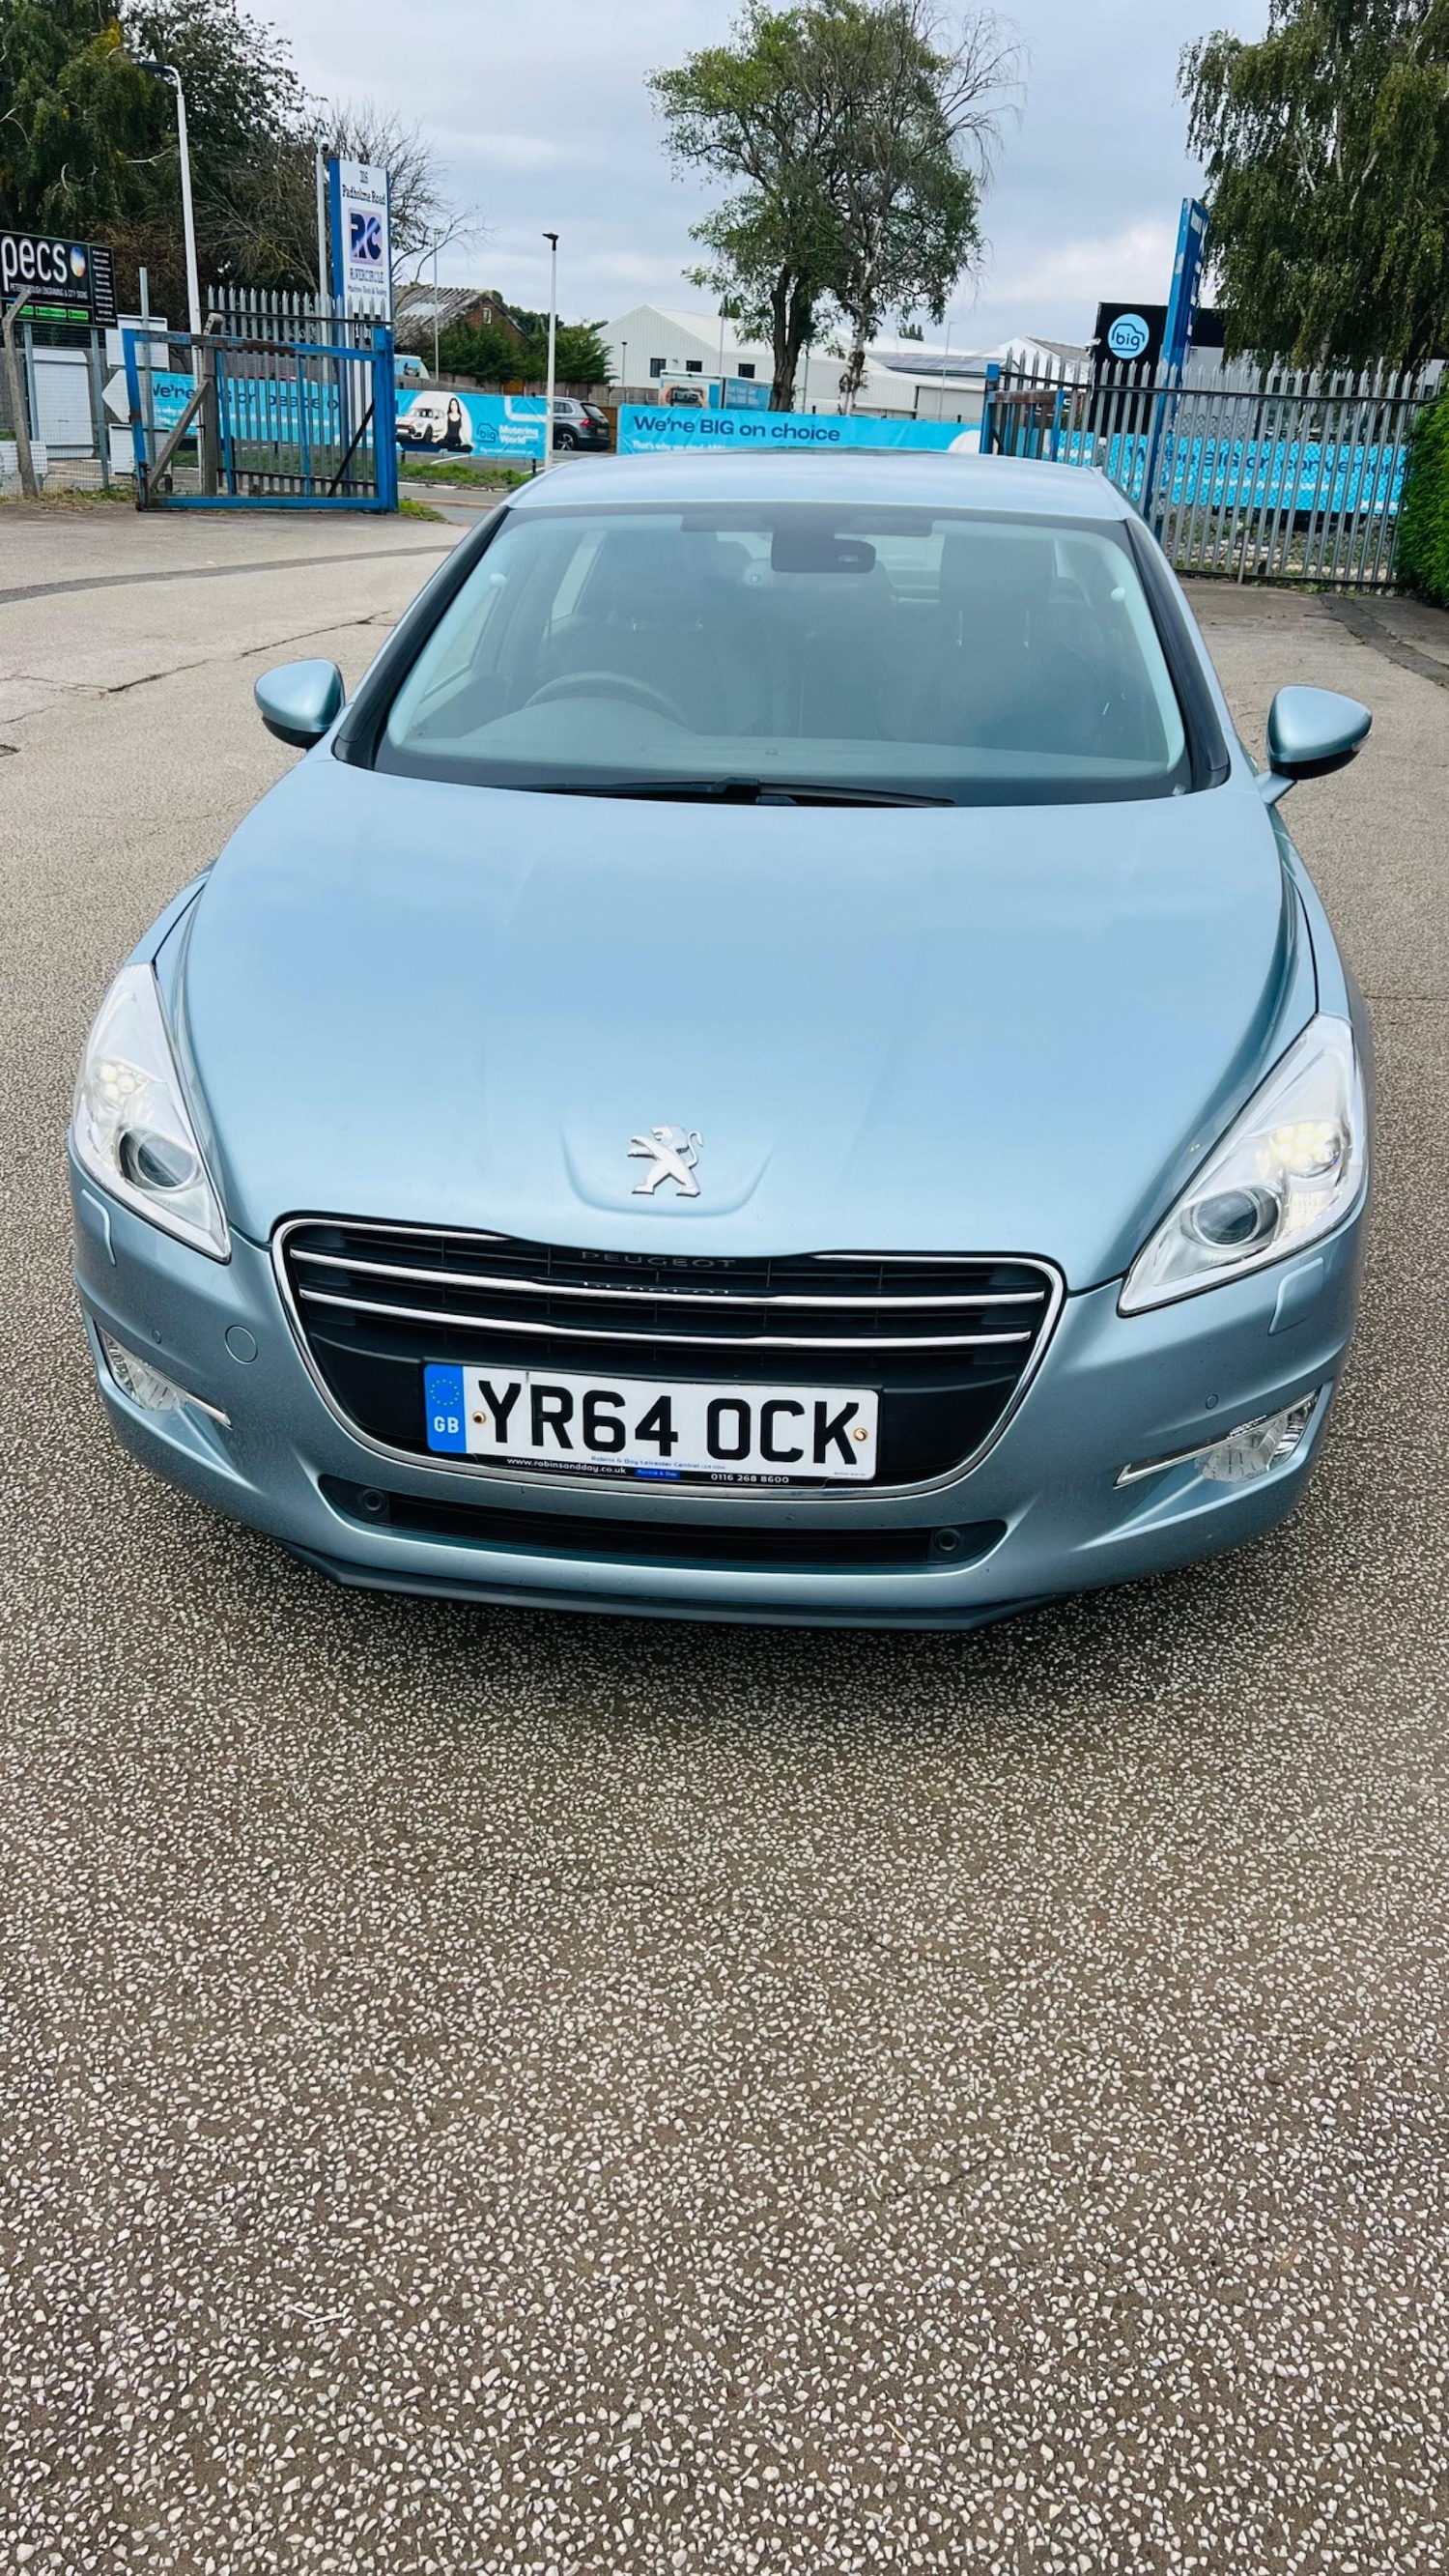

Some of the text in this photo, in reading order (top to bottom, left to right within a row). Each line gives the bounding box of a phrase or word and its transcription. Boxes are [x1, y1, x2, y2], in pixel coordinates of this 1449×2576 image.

[372, 190, 385, 206] Road
[0, 236, 68, 292] pecs
[1117, 332, 1140, 351] big
[633, 415, 840, 442] We're BIG on choice
[582, 1250, 736, 1268] PEUGEOT
[434, 1416, 460, 1434] GB
[478, 1380, 859, 1465] YR64 OCK
[507, 1457, 627, 1475] www.robinsandday.co.uk
[624, 1458, 639, 1468] Day
[710, 1473, 734, 1481] 0116
[760, 1475, 790, 1484] 8600
